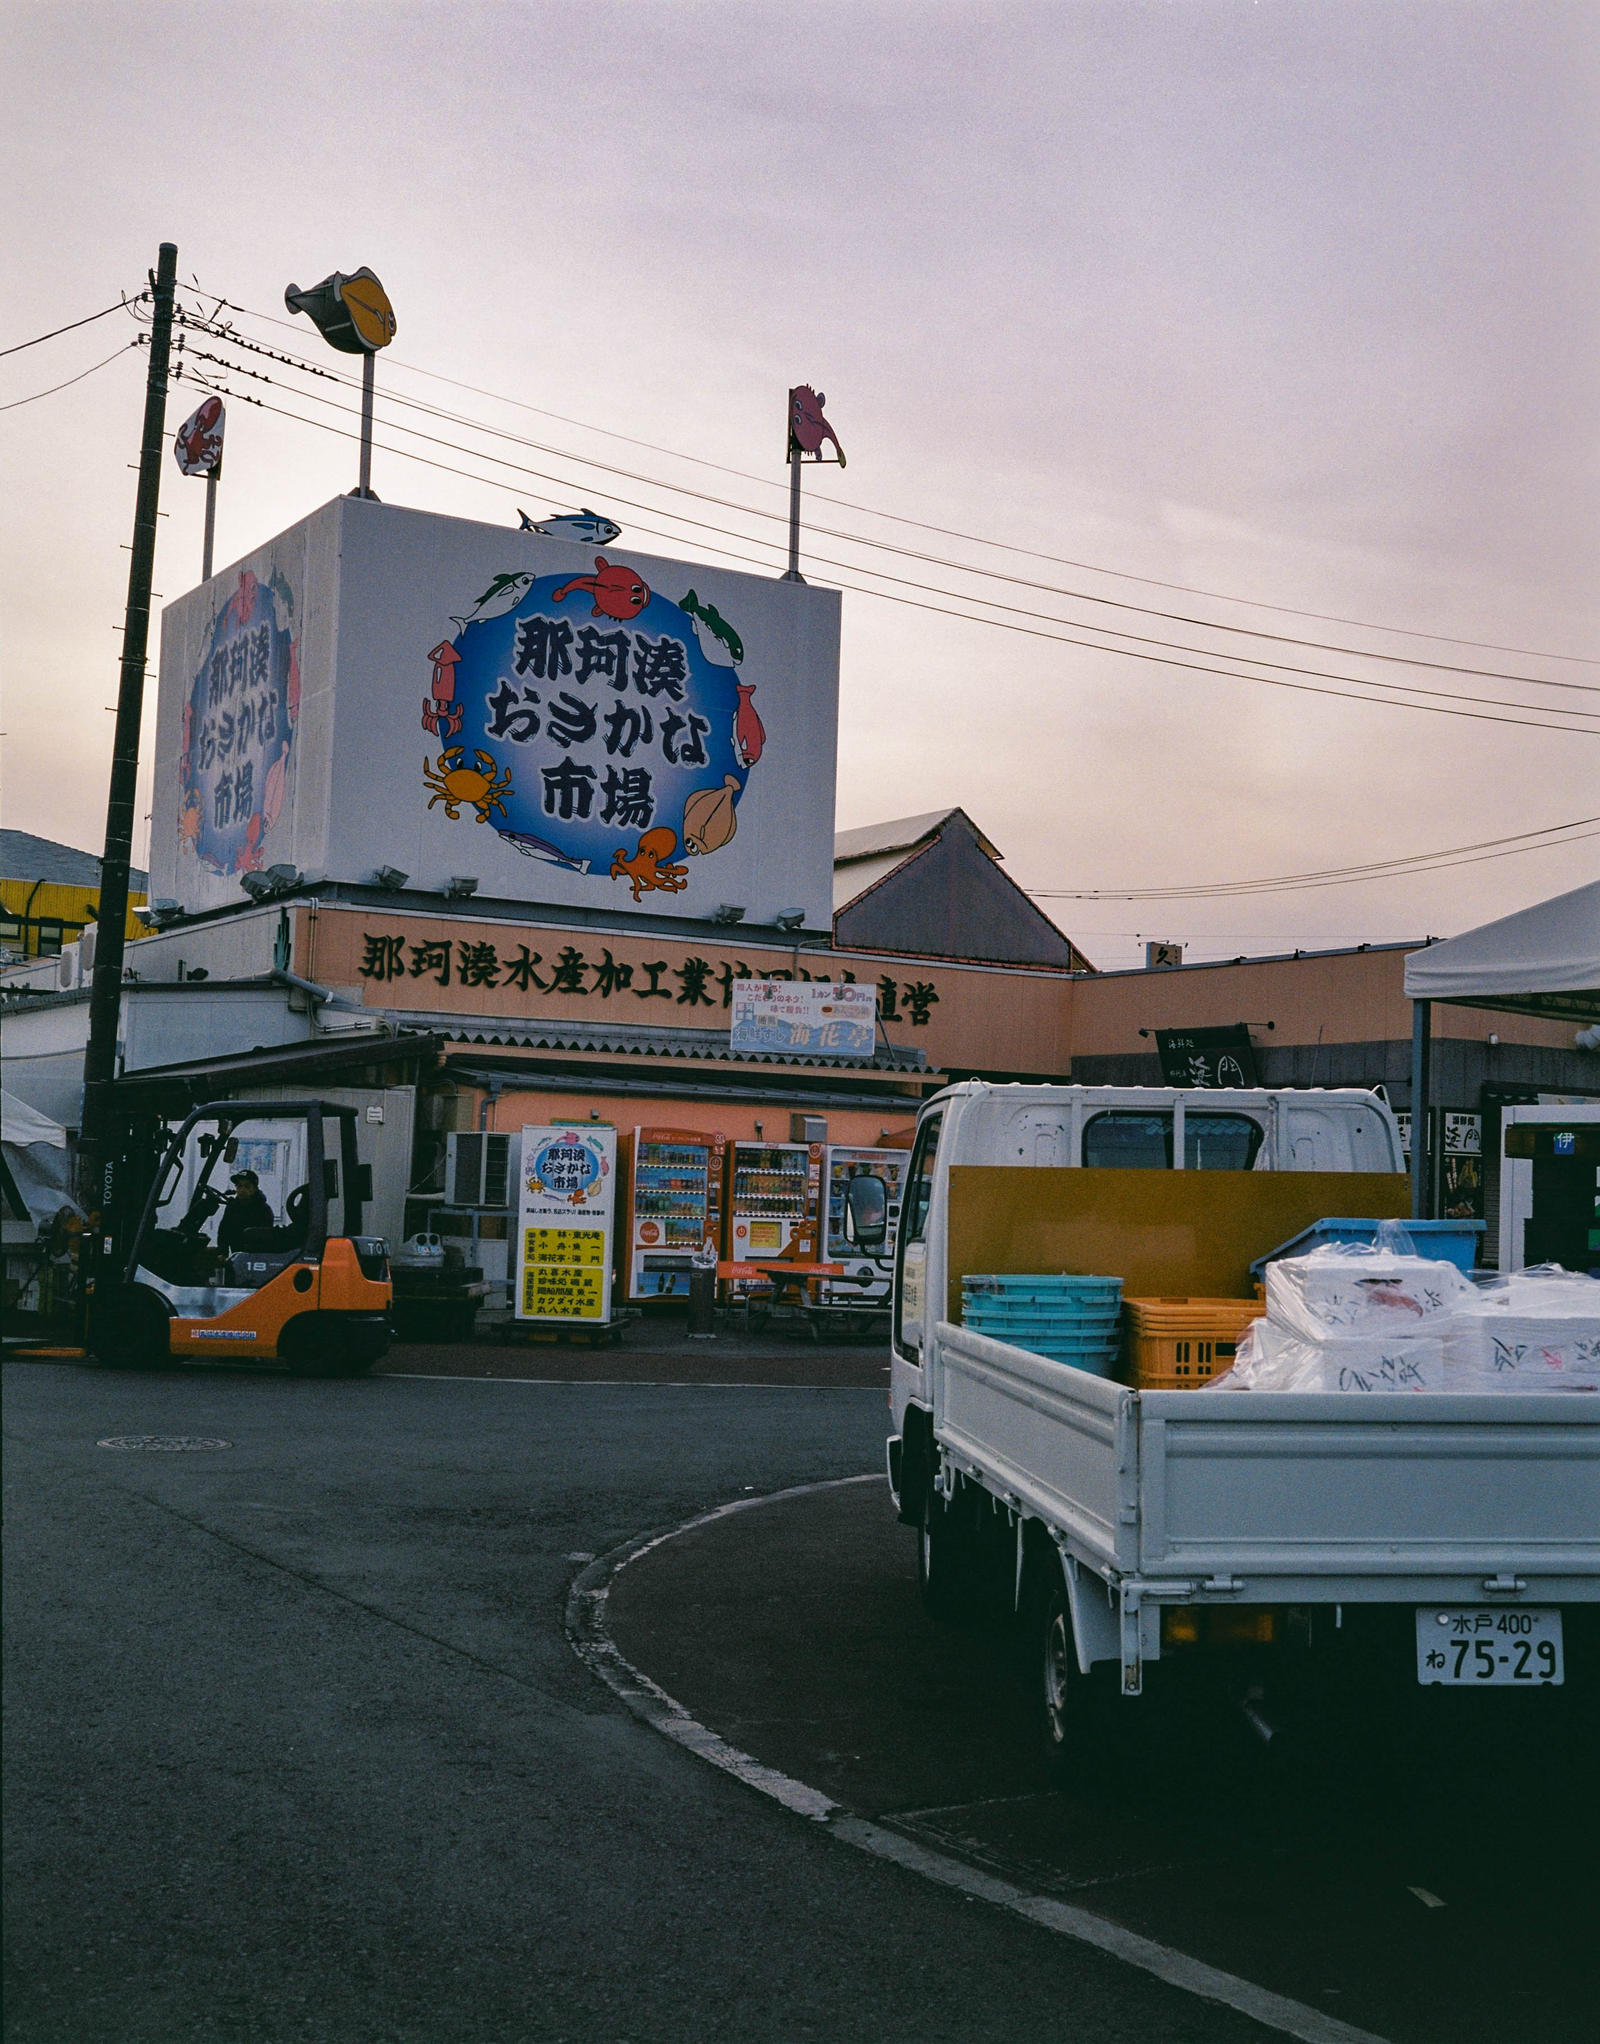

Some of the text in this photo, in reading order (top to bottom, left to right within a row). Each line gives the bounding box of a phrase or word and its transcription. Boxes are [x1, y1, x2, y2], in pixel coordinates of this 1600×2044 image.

[209, 624, 270, 708] 那珂湊
[517, 617, 687, 700] 那珂湊
[198, 691, 278, 770] おさかな
[487, 682, 710, 765] おさかな
[213, 761, 254, 830] 市場
[541, 757, 655, 828] 市場
[359, 932, 940, 1027] 那珂湊水産加工業協直営
[541, 1162, 591, 1175] おさかな
[547, 1148, 586, 1161] 那珂湊
[553, 1176, 579, 1190] 市場
[104, 1161, 113, 1206] TOYOTA
[247, 1261, 267, 1272] 18
[1452, 1614, 1532, 1634] 水戸 400
[1425, 1639, 1557, 1679] ね 75-29
